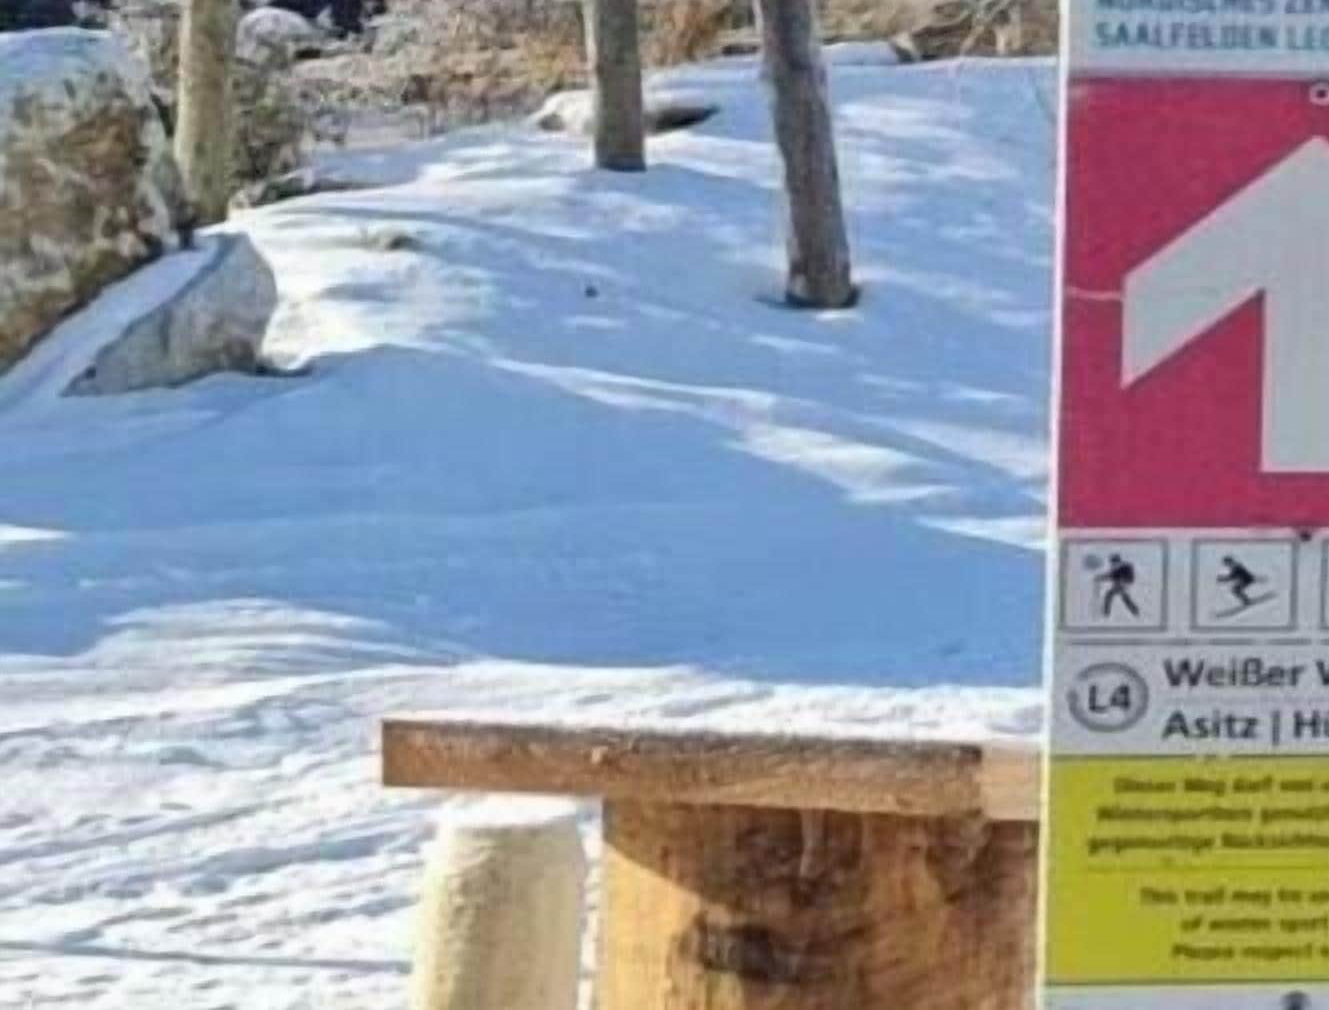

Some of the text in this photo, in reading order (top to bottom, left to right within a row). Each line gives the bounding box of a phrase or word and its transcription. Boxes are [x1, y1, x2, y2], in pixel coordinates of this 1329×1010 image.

[1163, 657, 1304, 688] Weißer
[1088, 684, 1131, 714] L4
[1162, 709, 1259, 739] Asitz
